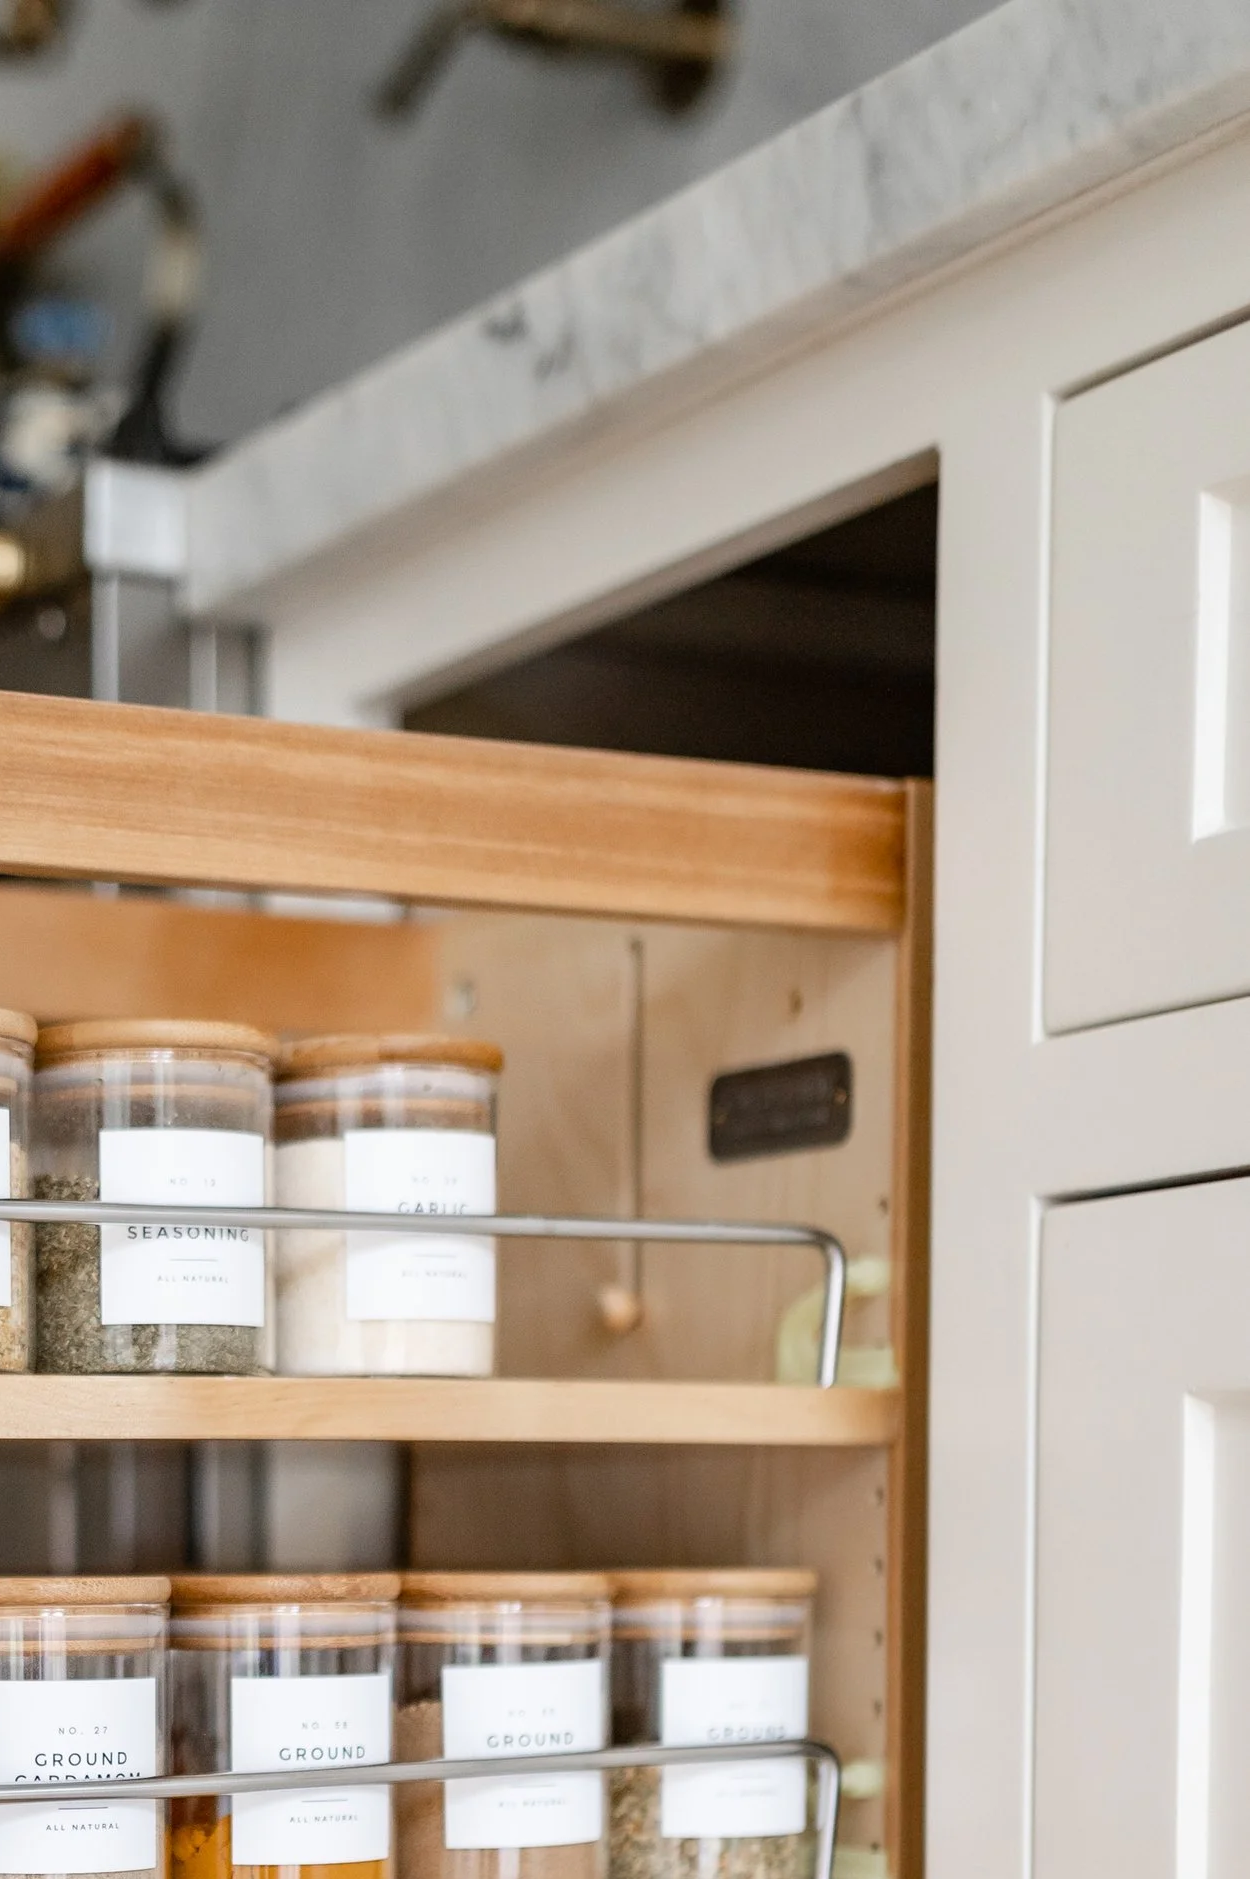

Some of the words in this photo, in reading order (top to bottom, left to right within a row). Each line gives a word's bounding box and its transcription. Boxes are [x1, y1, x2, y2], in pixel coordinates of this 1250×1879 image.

[127, 1225, 249, 1242] SEASONING
[58, 1727, 84, 1735] NO.
[94, 1726, 108, 1735] 27
[486, 1732, 574, 1748] GROUND
[34, 1751, 128, 1767] GROUND
[279, 1746, 366, 1761] GROUND
[72, 1823, 120, 1831] NATURAL
